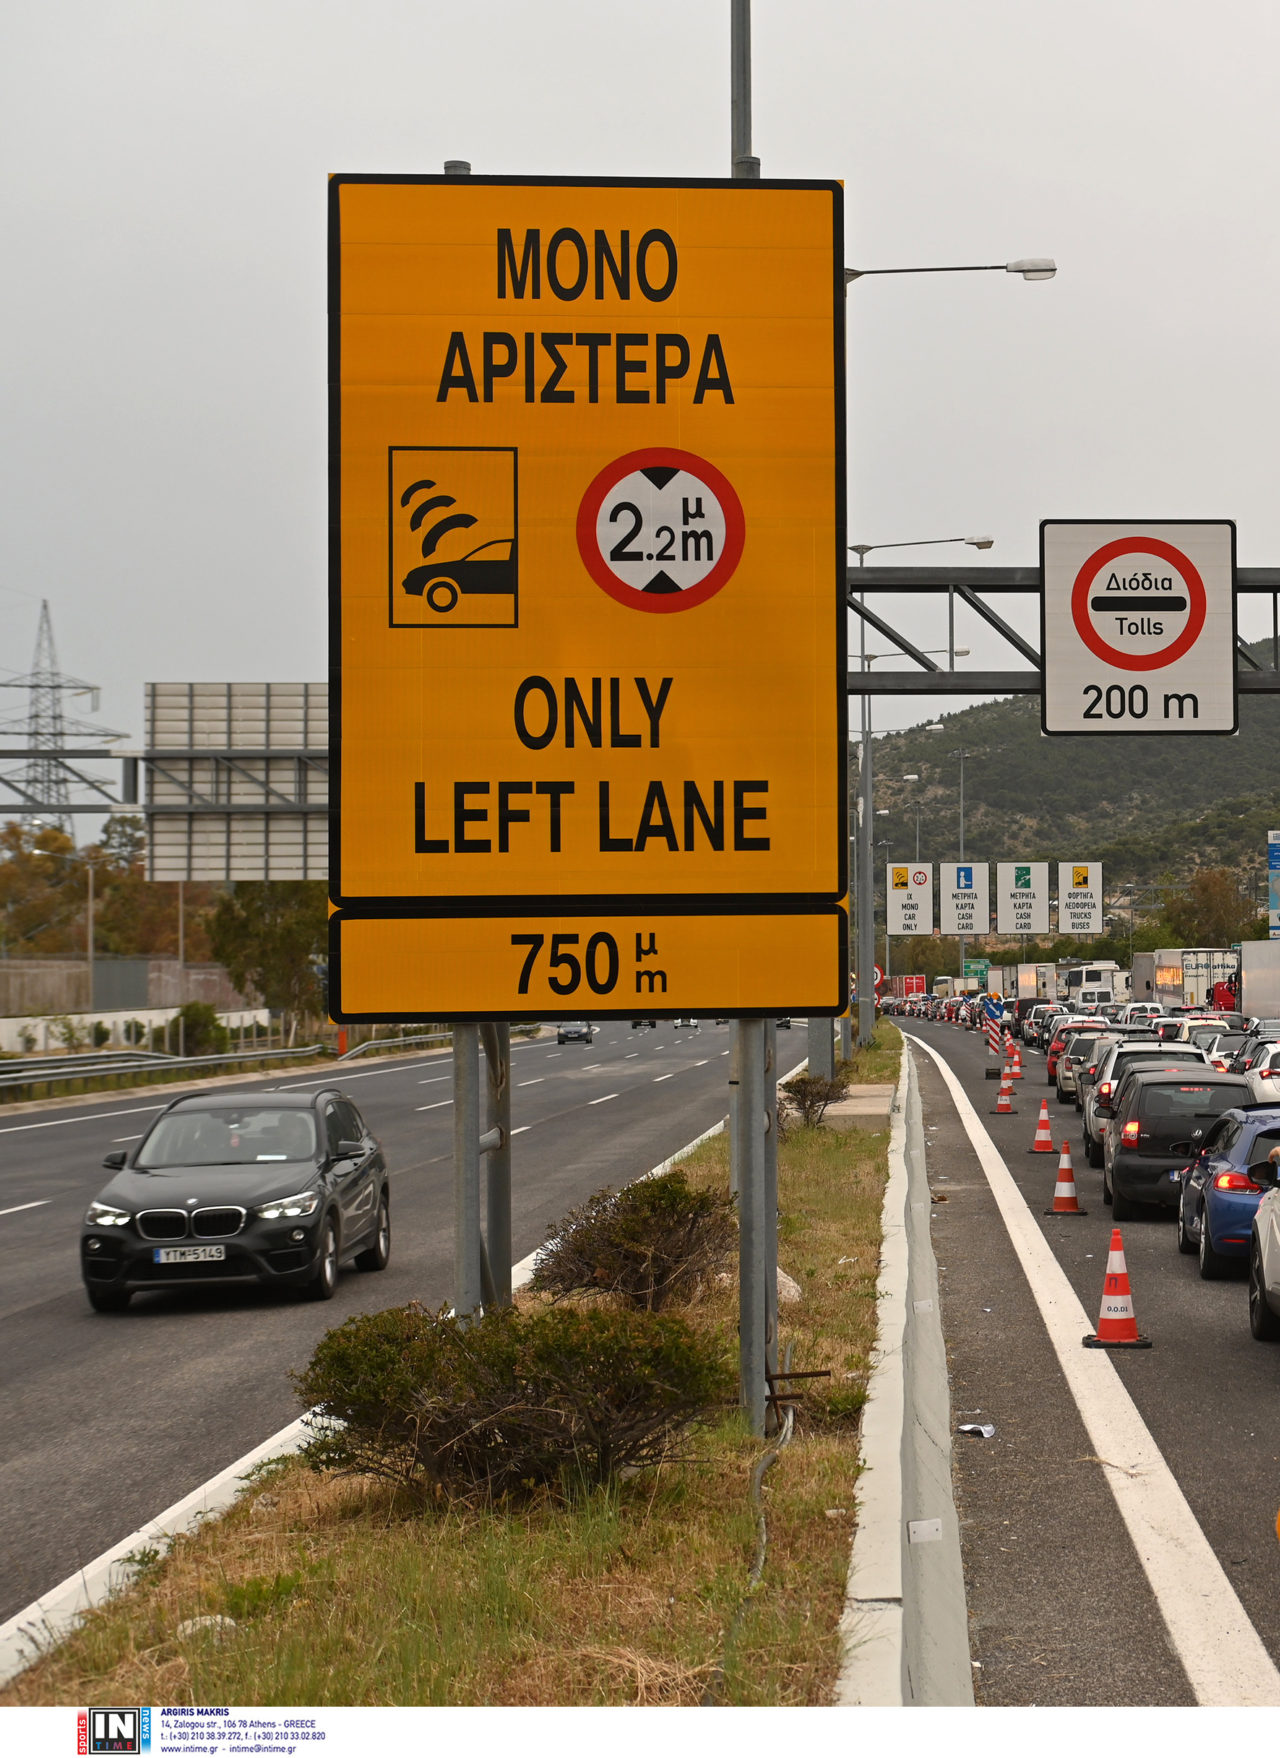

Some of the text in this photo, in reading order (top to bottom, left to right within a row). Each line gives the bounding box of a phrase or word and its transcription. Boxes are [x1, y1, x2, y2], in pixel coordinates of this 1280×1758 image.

[497, 227, 678, 302] ΜΟΝΟ
[436, 331, 735, 404] ΑΡΙΣΤΕΡΑ
[609, 501, 676, 562] 2.2
[1106, 573, 1172, 590] Διόδια
[1115, 618, 1164, 635] Tolls
[514, 675, 673, 750] ONLY
[1083, 684, 1198, 719] 200 m
[414, 780, 770, 853] LEFT LANE
[952, 892, 978, 900] ΜΕΤΡΗΤΑ
[1010, 892, 1036, 900] ΜΕΤΡΗΤΑ
[1014, 902, 1032, 910] ΚΑΡΤΑ
[511, 931, 667, 995] 750 m
